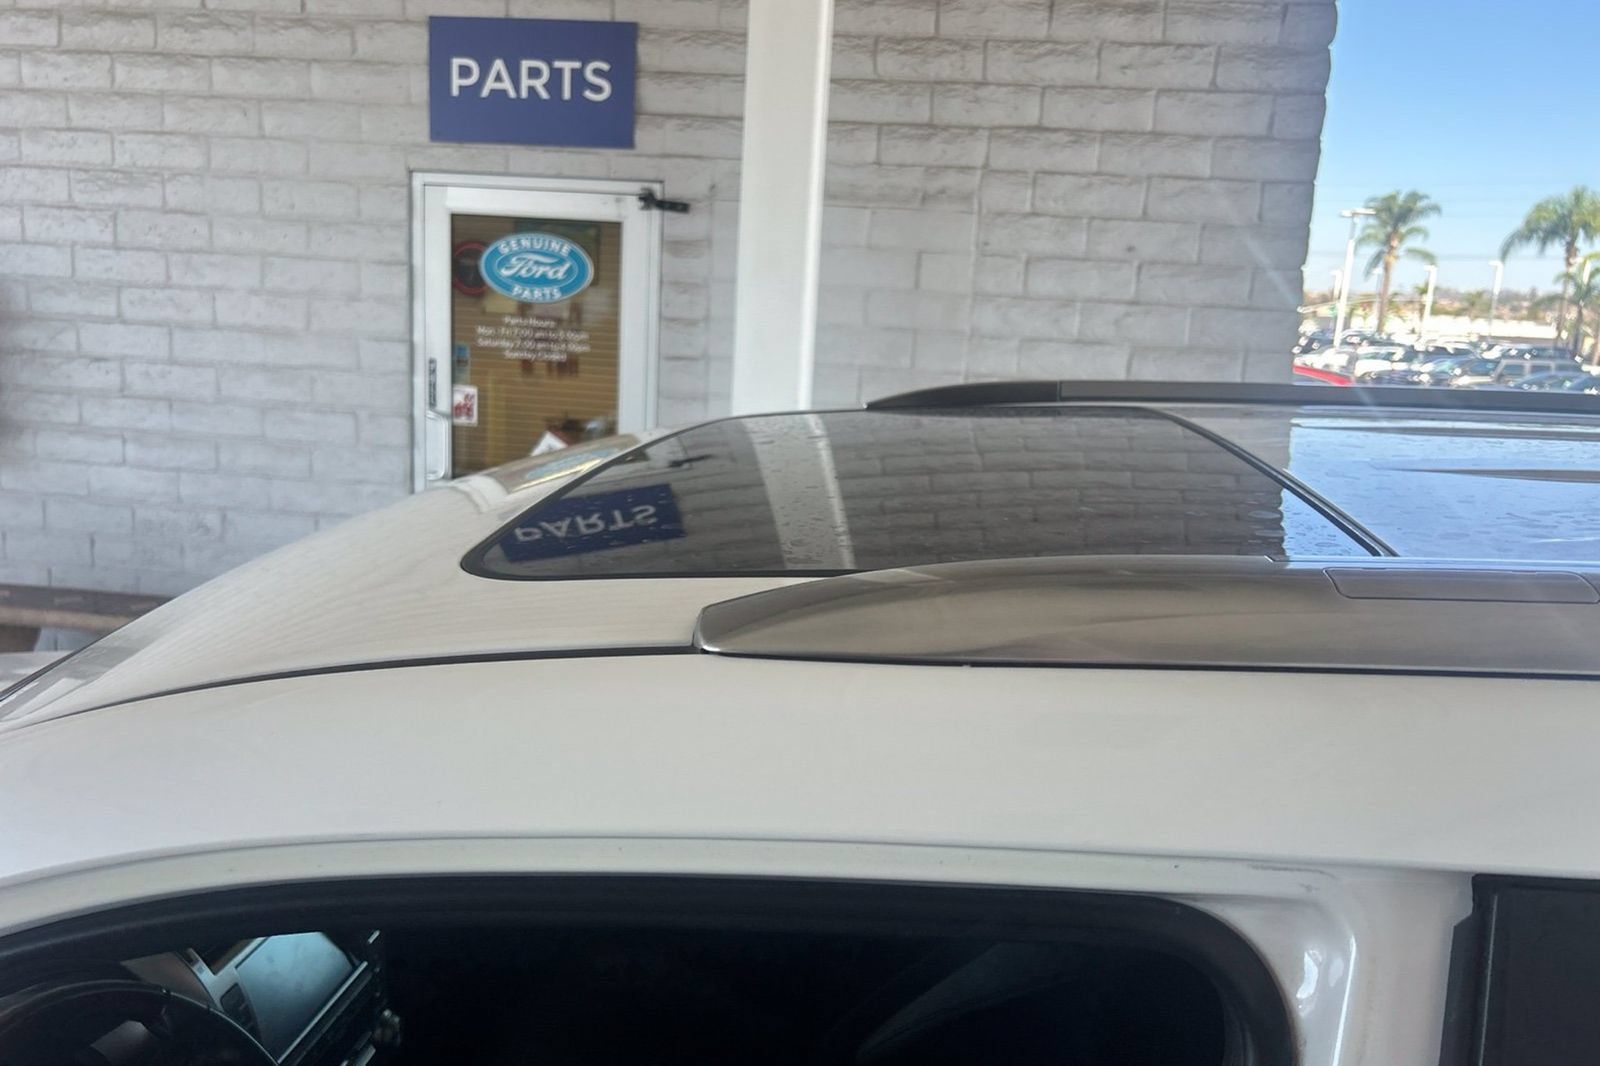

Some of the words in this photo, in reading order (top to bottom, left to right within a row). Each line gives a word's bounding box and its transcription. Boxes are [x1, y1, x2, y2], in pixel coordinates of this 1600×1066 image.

[451, 57, 613, 102] PARTS
[498, 237, 571, 257] GENUINE
[500, 252, 572, 280] Ford
[511, 285, 562, 300] PARTS
